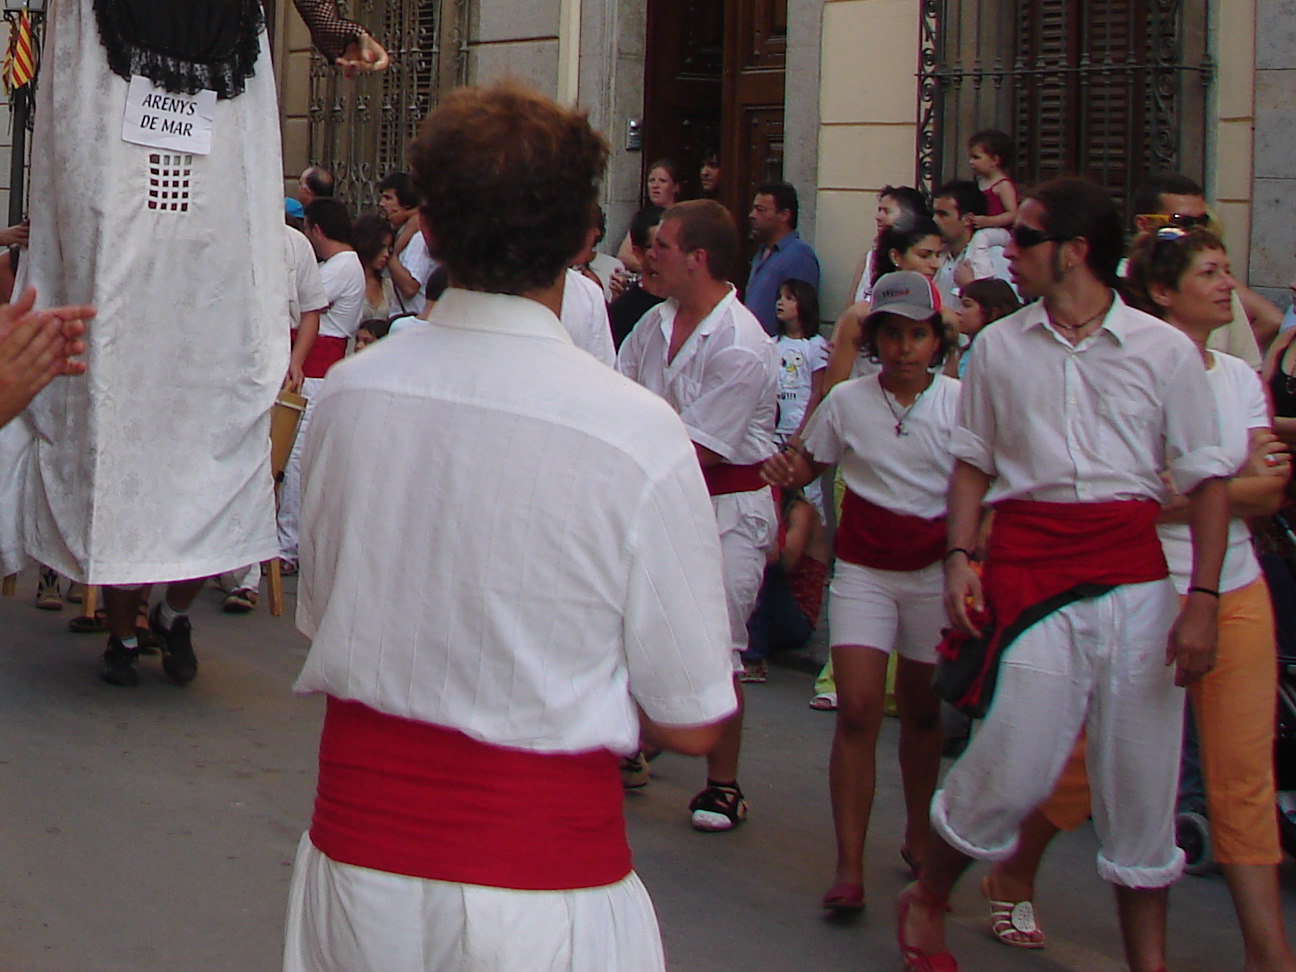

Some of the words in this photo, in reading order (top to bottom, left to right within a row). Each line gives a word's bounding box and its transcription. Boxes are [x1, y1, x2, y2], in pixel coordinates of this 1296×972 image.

[142, 94, 198, 116] ARENYS
[140, 114, 159, 130] DE
[161, 119, 193, 137] MAR
